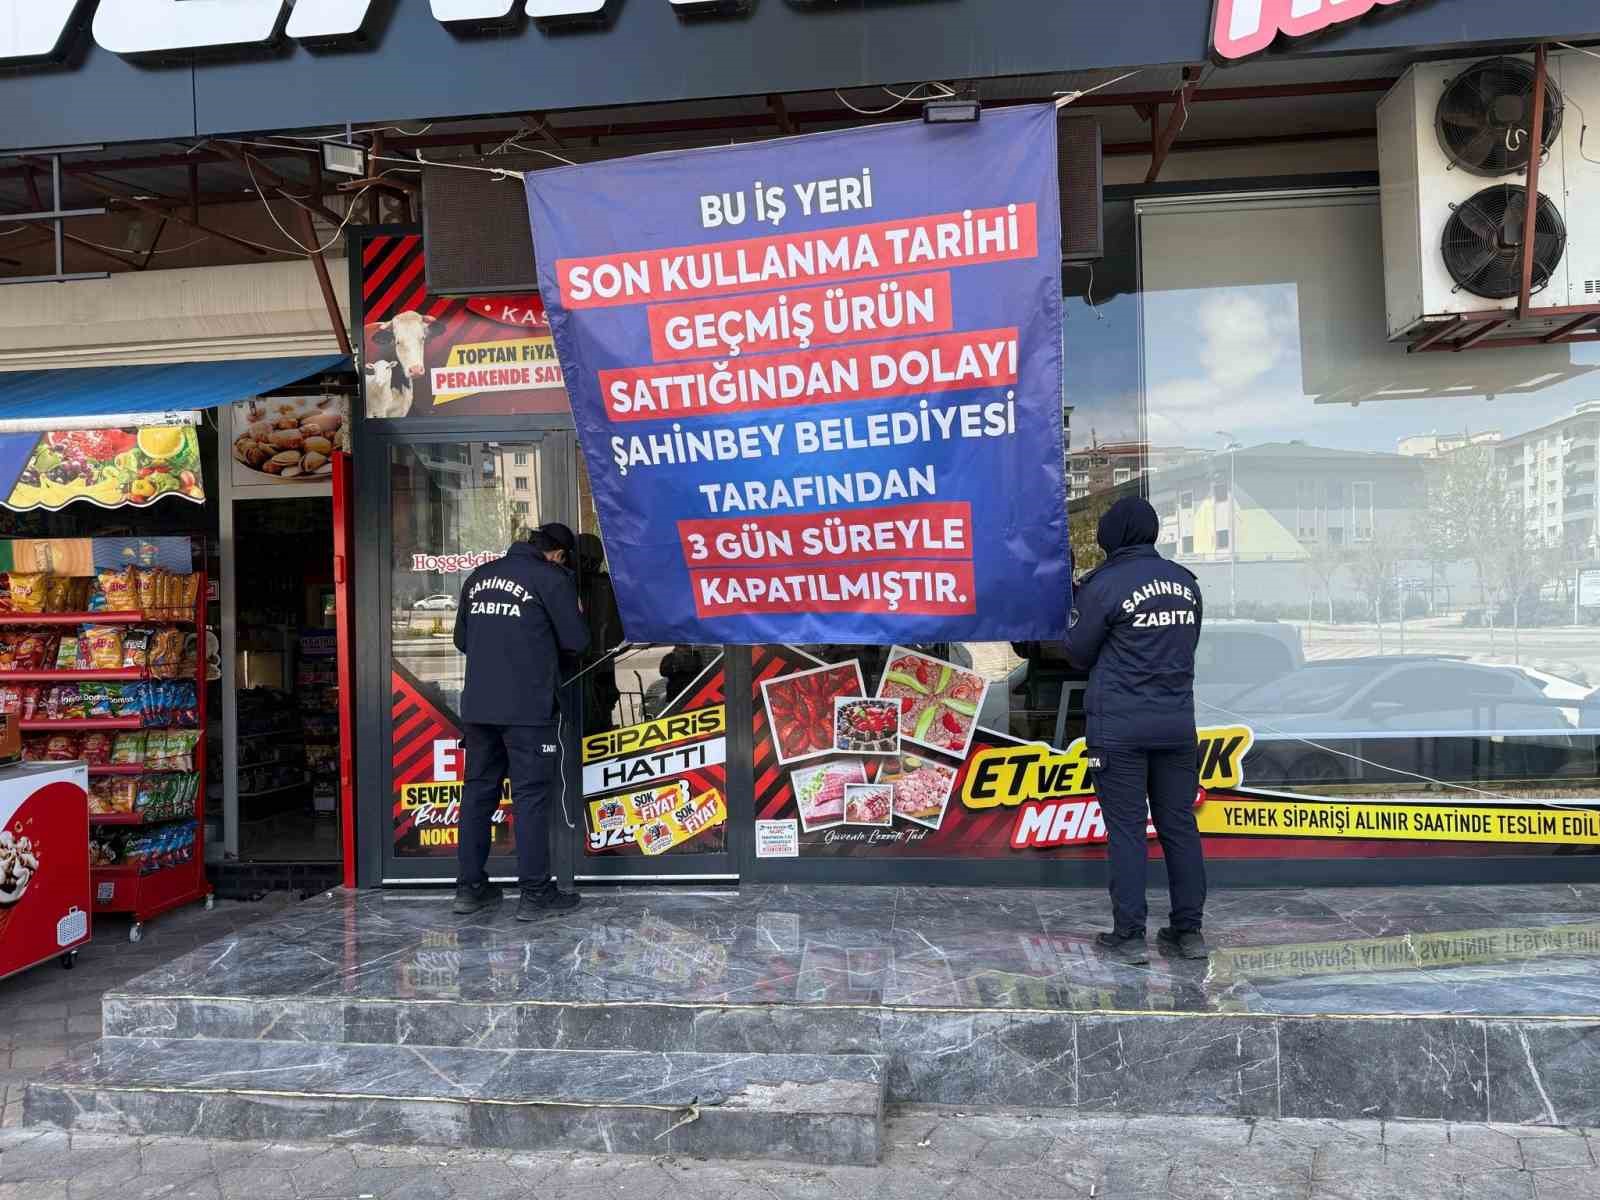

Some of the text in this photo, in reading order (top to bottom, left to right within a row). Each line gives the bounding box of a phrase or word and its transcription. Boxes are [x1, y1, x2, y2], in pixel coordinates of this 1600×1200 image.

[700, 168, 873, 228] BU İŞ YERİ
[568, 203, 1020, 300] SON KULLANMA TARİHİ
[664, 282, 934, 356] GEÇMİŞ ÜRÜN
[457, 345, 517, 364] TOPTAN
[609, 340, 1018, 413] SATTIĞINDAN DOLAYI
[435, 367, 530, 390] PERAKENDE
[612, 390, 1015, 476] ŞAHİNBEY BELEDİYESİ
[698, 464, 936, 513] TARAFINDAN
[687, 518, 965, 560] 3 GÜN SÜREYLE
[470, 602, 521, 617] ZABITA
[700, 571, 968, 611] KAPATILMIŞTIR.
[1132, 610, 1195, 627] ZABITA
[603, 744, 706, 788] HATTI
[970, 754, 1041, 799] ET
[1038, 762, 1078, 793] VE
[1224, 807, 1277, 826] YEMEK
[1283, 804, 1350, 833] SİPARİŞİ
[1356, 810, 1408, 831] ALINIR
[1414, 809, 1492, 834] SAATİNDE
[1497, 811, 1556, 835] TESLİM
